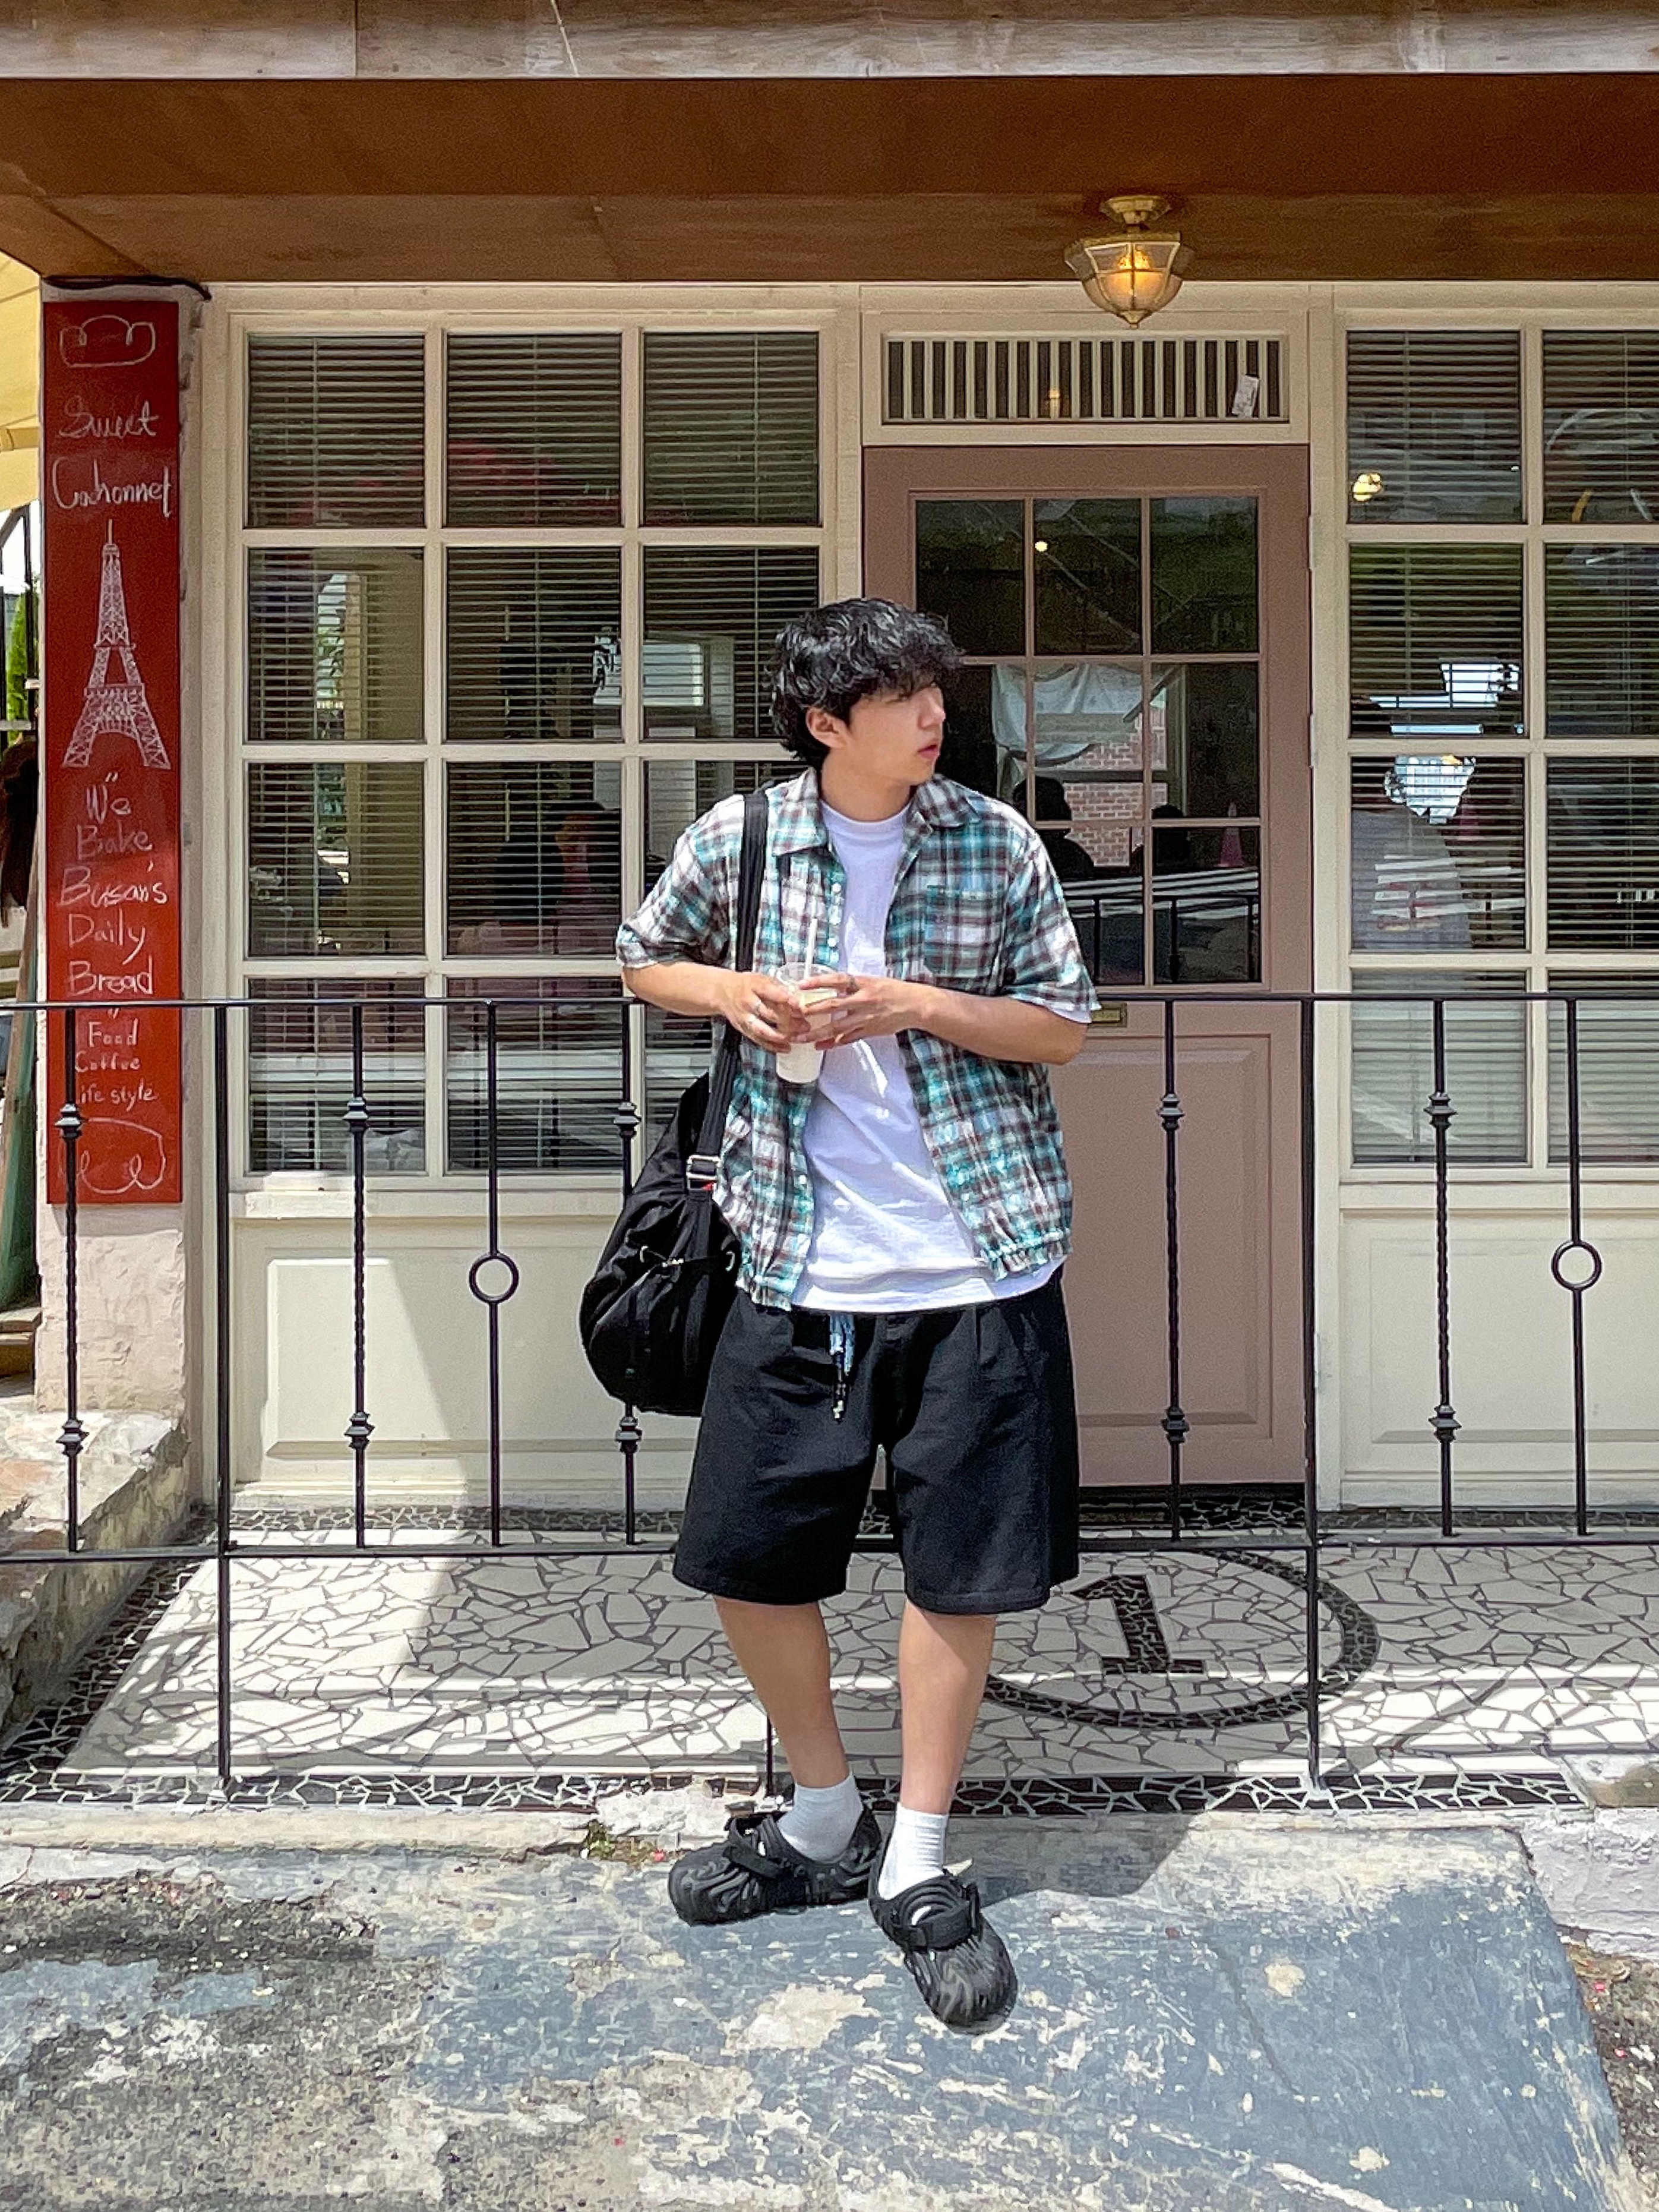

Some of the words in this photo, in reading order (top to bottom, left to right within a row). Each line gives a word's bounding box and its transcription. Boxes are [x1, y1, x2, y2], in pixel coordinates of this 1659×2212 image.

[58, 395, 159, 438] Sweet
[77, 822, 153, 860] Bake
[59, 860, 168, 908] Busan's
[68, 908, 146, 965] Daily
[68, 955, 153, 996] Bread
[88, 1018, 138, 1047] Food
[75, 1050, 141, 1072] Coffee
[75, 1084, 105, 1104] ife
[110, 1077, 158, 1112] style
